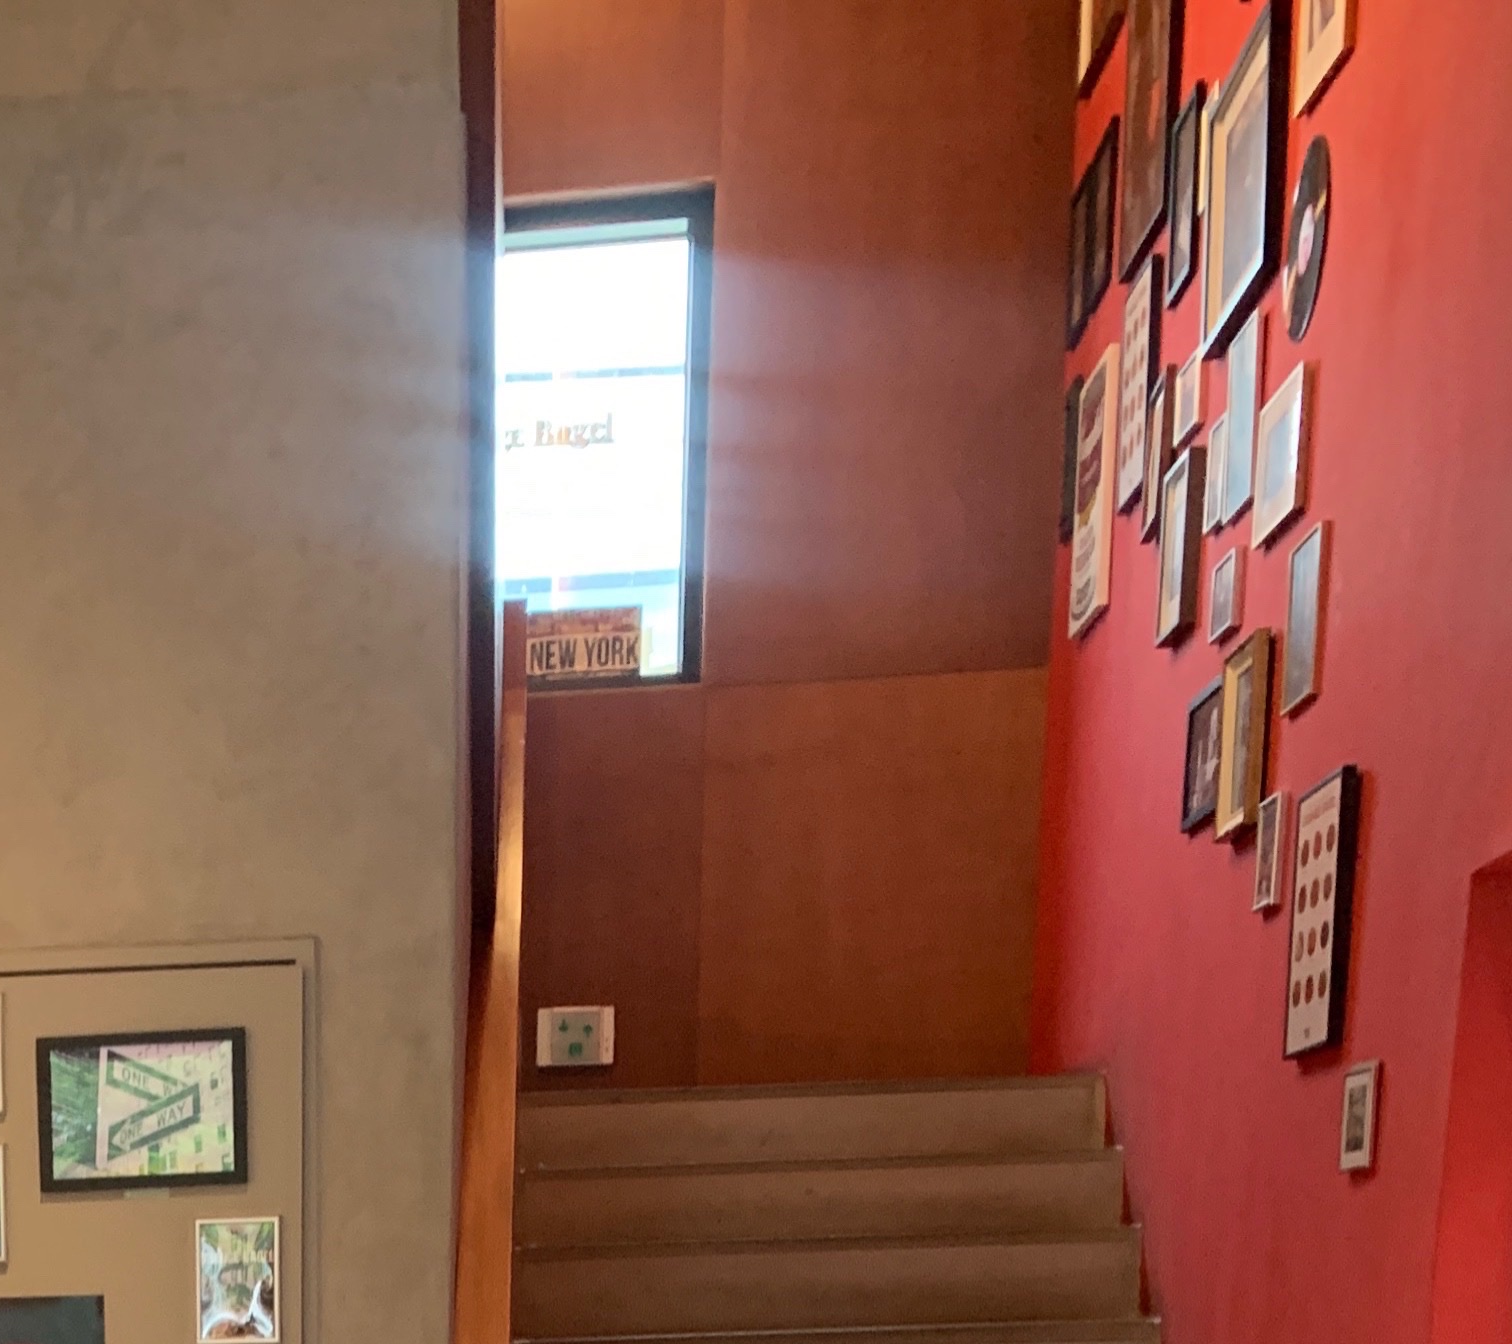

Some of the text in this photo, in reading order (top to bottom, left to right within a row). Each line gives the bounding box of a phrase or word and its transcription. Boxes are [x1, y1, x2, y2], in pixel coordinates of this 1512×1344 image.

[530, 635, 638, 672] NEW YORK
[156, 1101, 186, 1127] WAY
